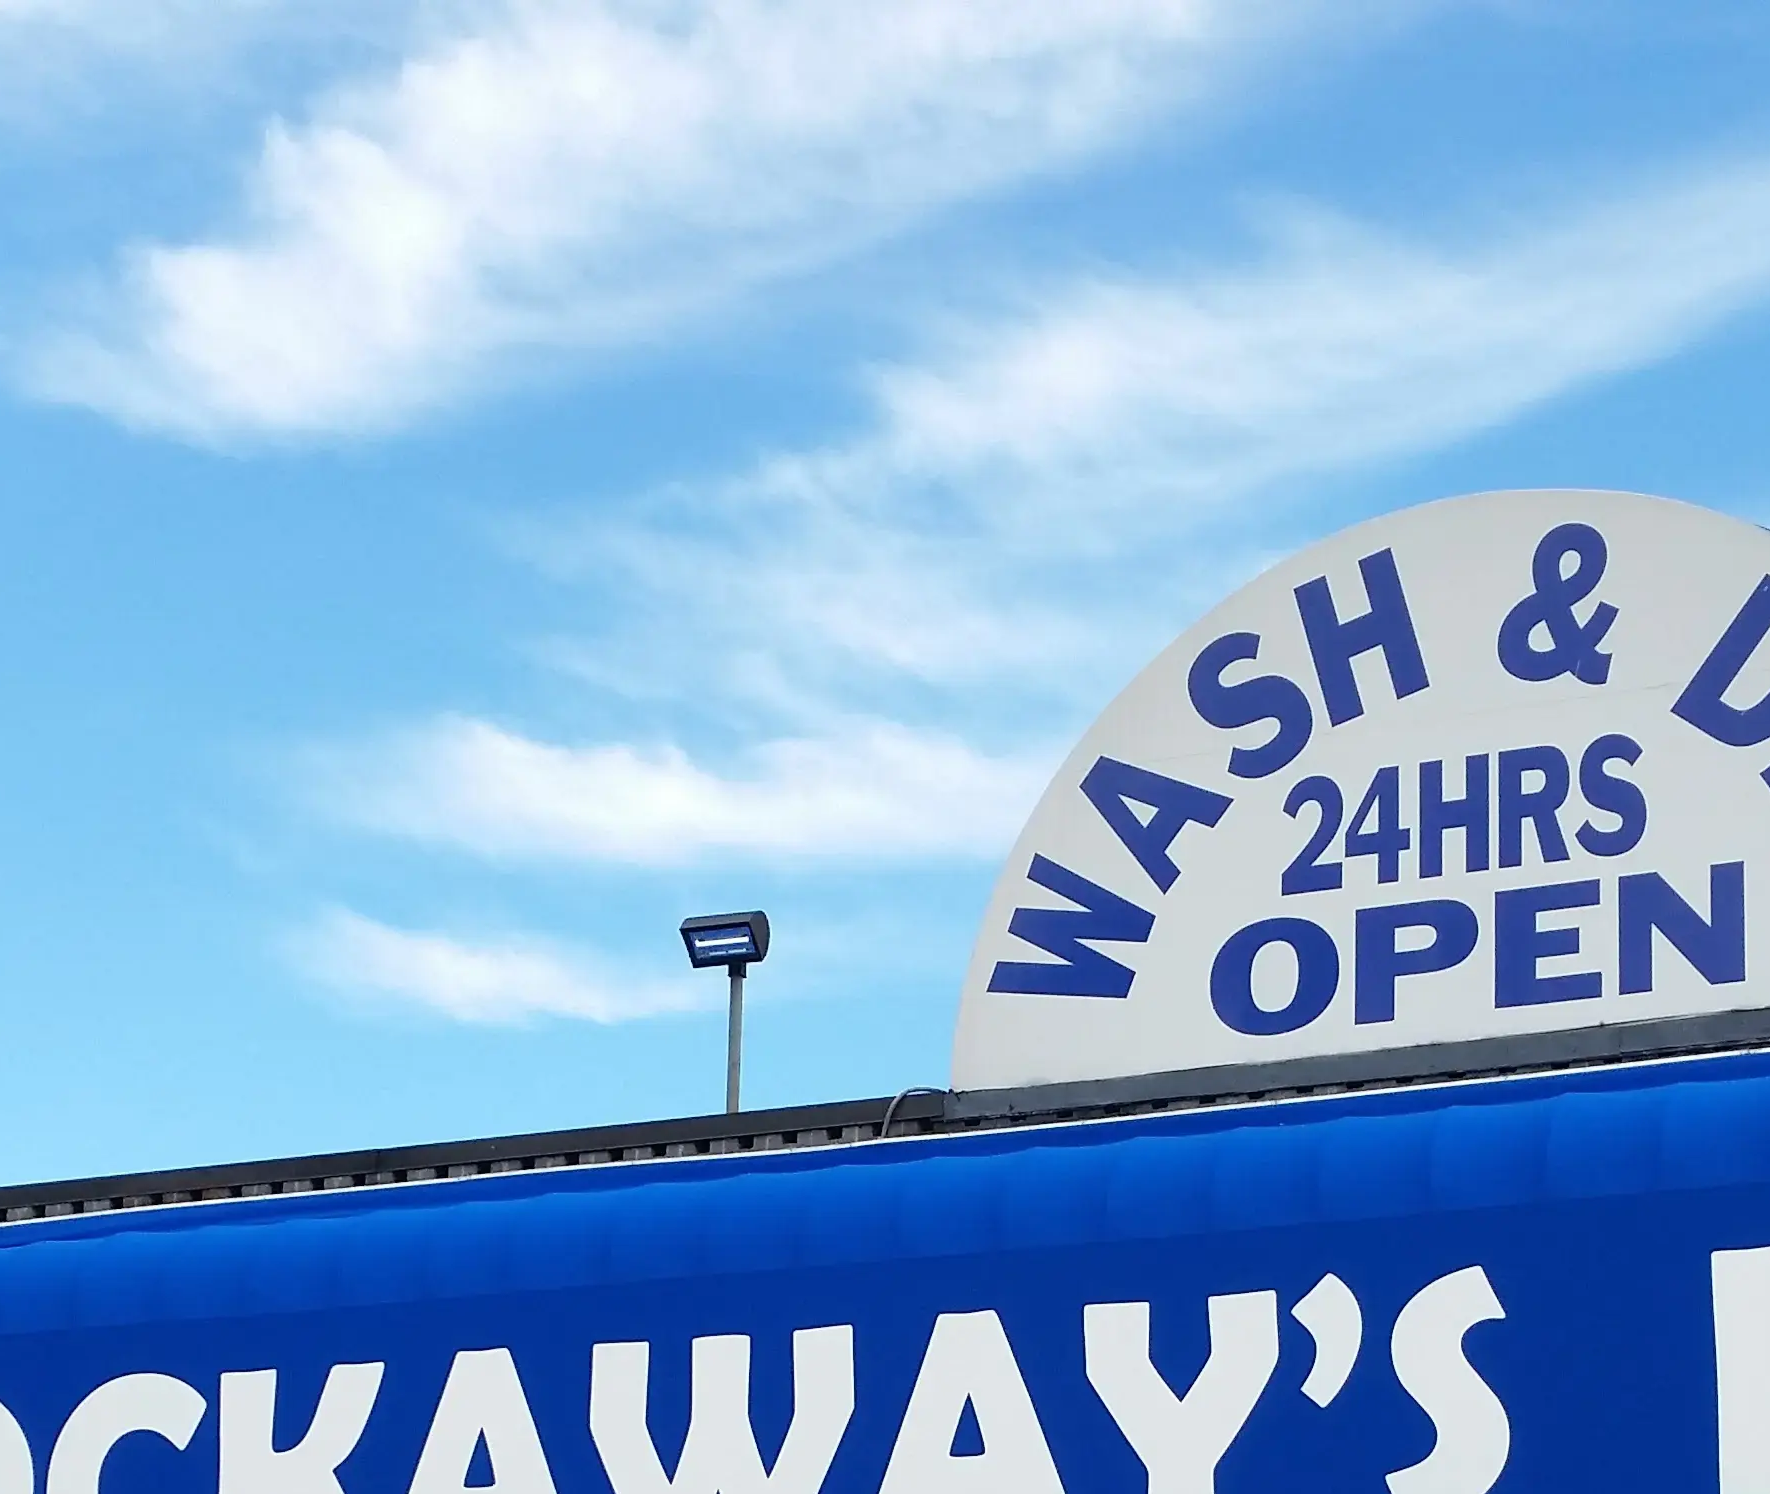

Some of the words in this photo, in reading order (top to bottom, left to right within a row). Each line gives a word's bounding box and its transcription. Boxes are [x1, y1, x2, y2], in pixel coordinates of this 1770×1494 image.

[985, 547, 1430, 999] WASH
[1497, 521, 1619, 685] &
[1281, 733, 1647, 896] 24HRS
[1210, 860, 1746, 1037] OPEN
